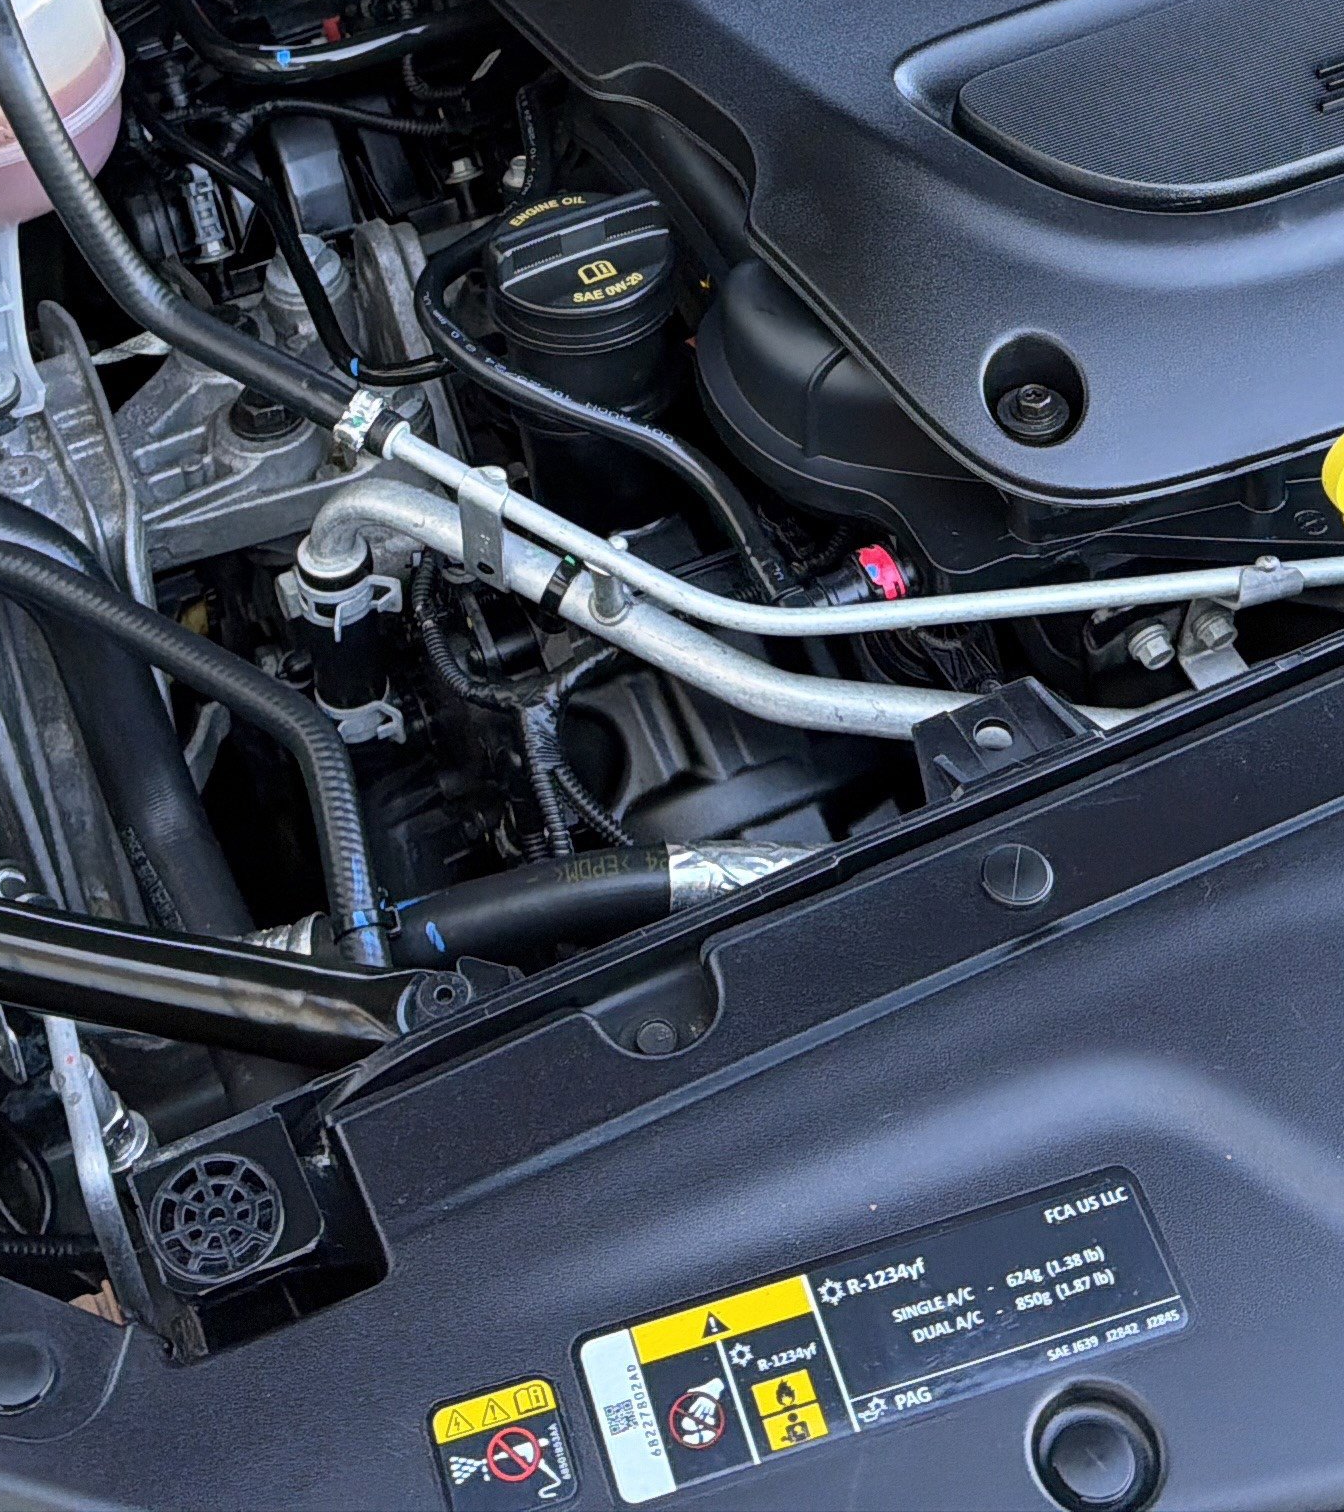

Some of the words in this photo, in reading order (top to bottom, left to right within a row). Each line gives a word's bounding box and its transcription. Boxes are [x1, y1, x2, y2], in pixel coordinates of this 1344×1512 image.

[509, 199, 560, 228] ENGINE
[561, 195, 587, 206] OIL
[572, 288, 605, 304] SAE
[605, 271, 645, 297] 0W-20
[1043, 1202, 1075, 1225] FCA
[1076, 1196, 1101, 1215] US
[1101, 1186, 1130, 1207] LLC
[846, 1256, 926, 1296] R-1234yf
[891, 1296, 948, 1323] SINGLE
[947, 1286, 976, 1308] A/C
[1006, 1267, 1044, 1290] 624g
[1046, 1250, 1084, 1278] (1.38
[1084, 1244, 1106, 1264] lb)
[911, 1319, 955, 1344] DUAL
[956, 1308, 985, 1331] A/C
[1015, 1291, 1054, 1314] 850g
[1055, 1274, 1093, 1301] (1.87
[1093, 1267, 1116, 1286] lb)
[1047, 1345, 1072, 1362] SAE
[1072, 1335, 1099, 1356] J639
[1106, 1323, 1141, 1344] J2842
[1146, 1309, 1181, 1331] J2845
[756, 1341, 816, 1372] R-1234yf
[894, 1386, 933, 1411] PAG
